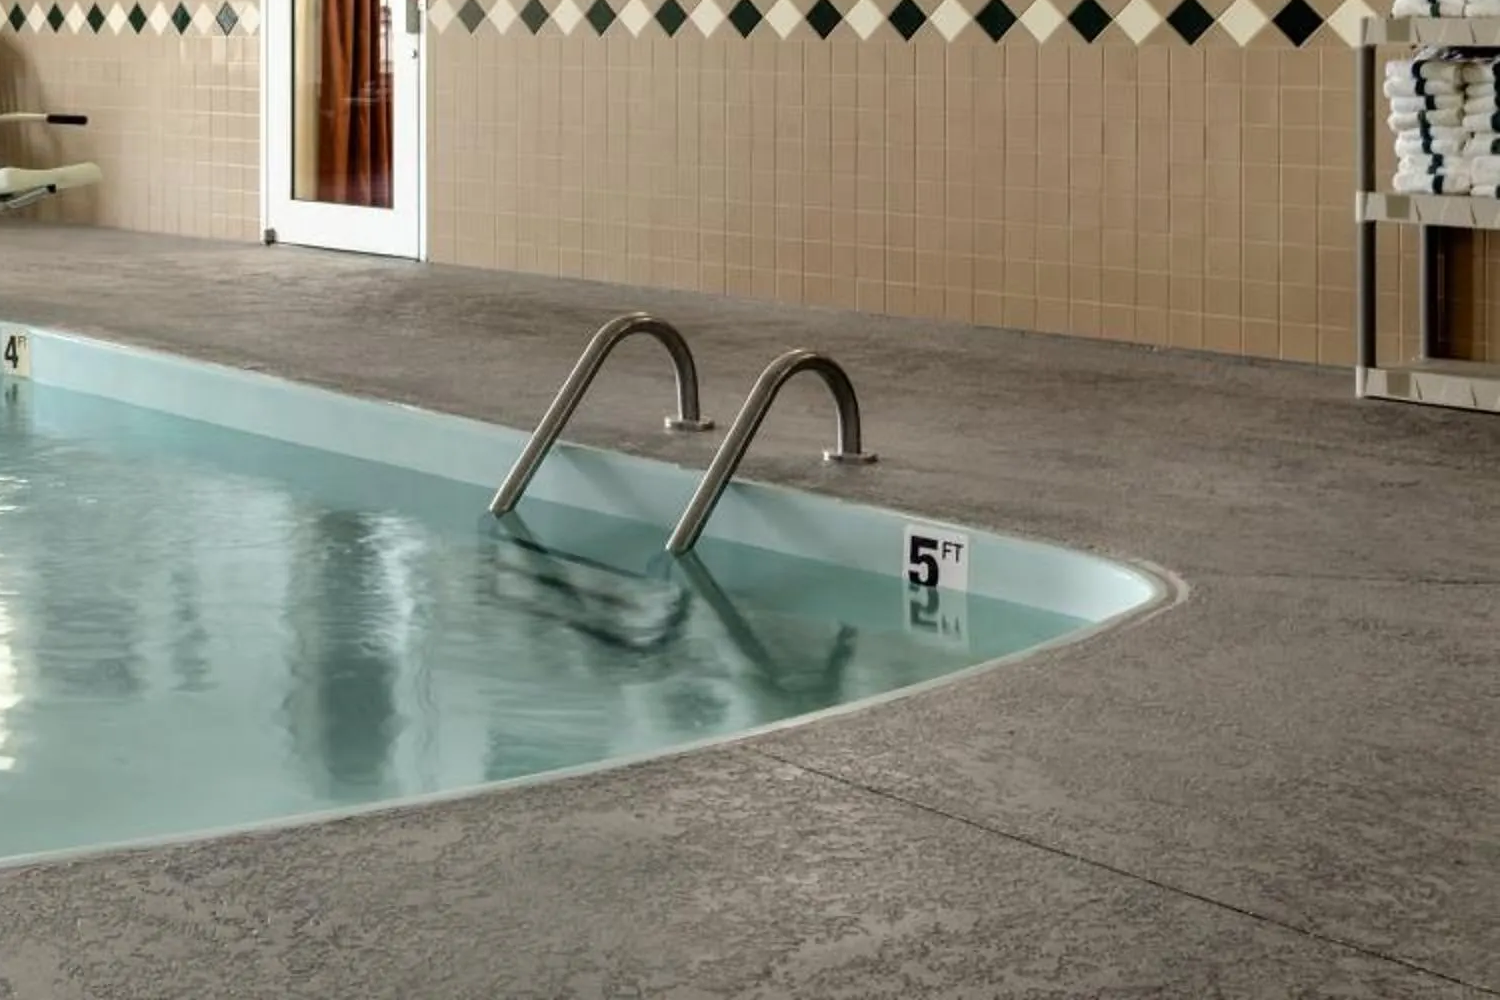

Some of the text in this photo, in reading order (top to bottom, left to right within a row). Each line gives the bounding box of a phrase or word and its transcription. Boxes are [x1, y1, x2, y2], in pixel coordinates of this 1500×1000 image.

[4, 335, 19, 369] 4
[908, 535, 964, 587] 5 FT
